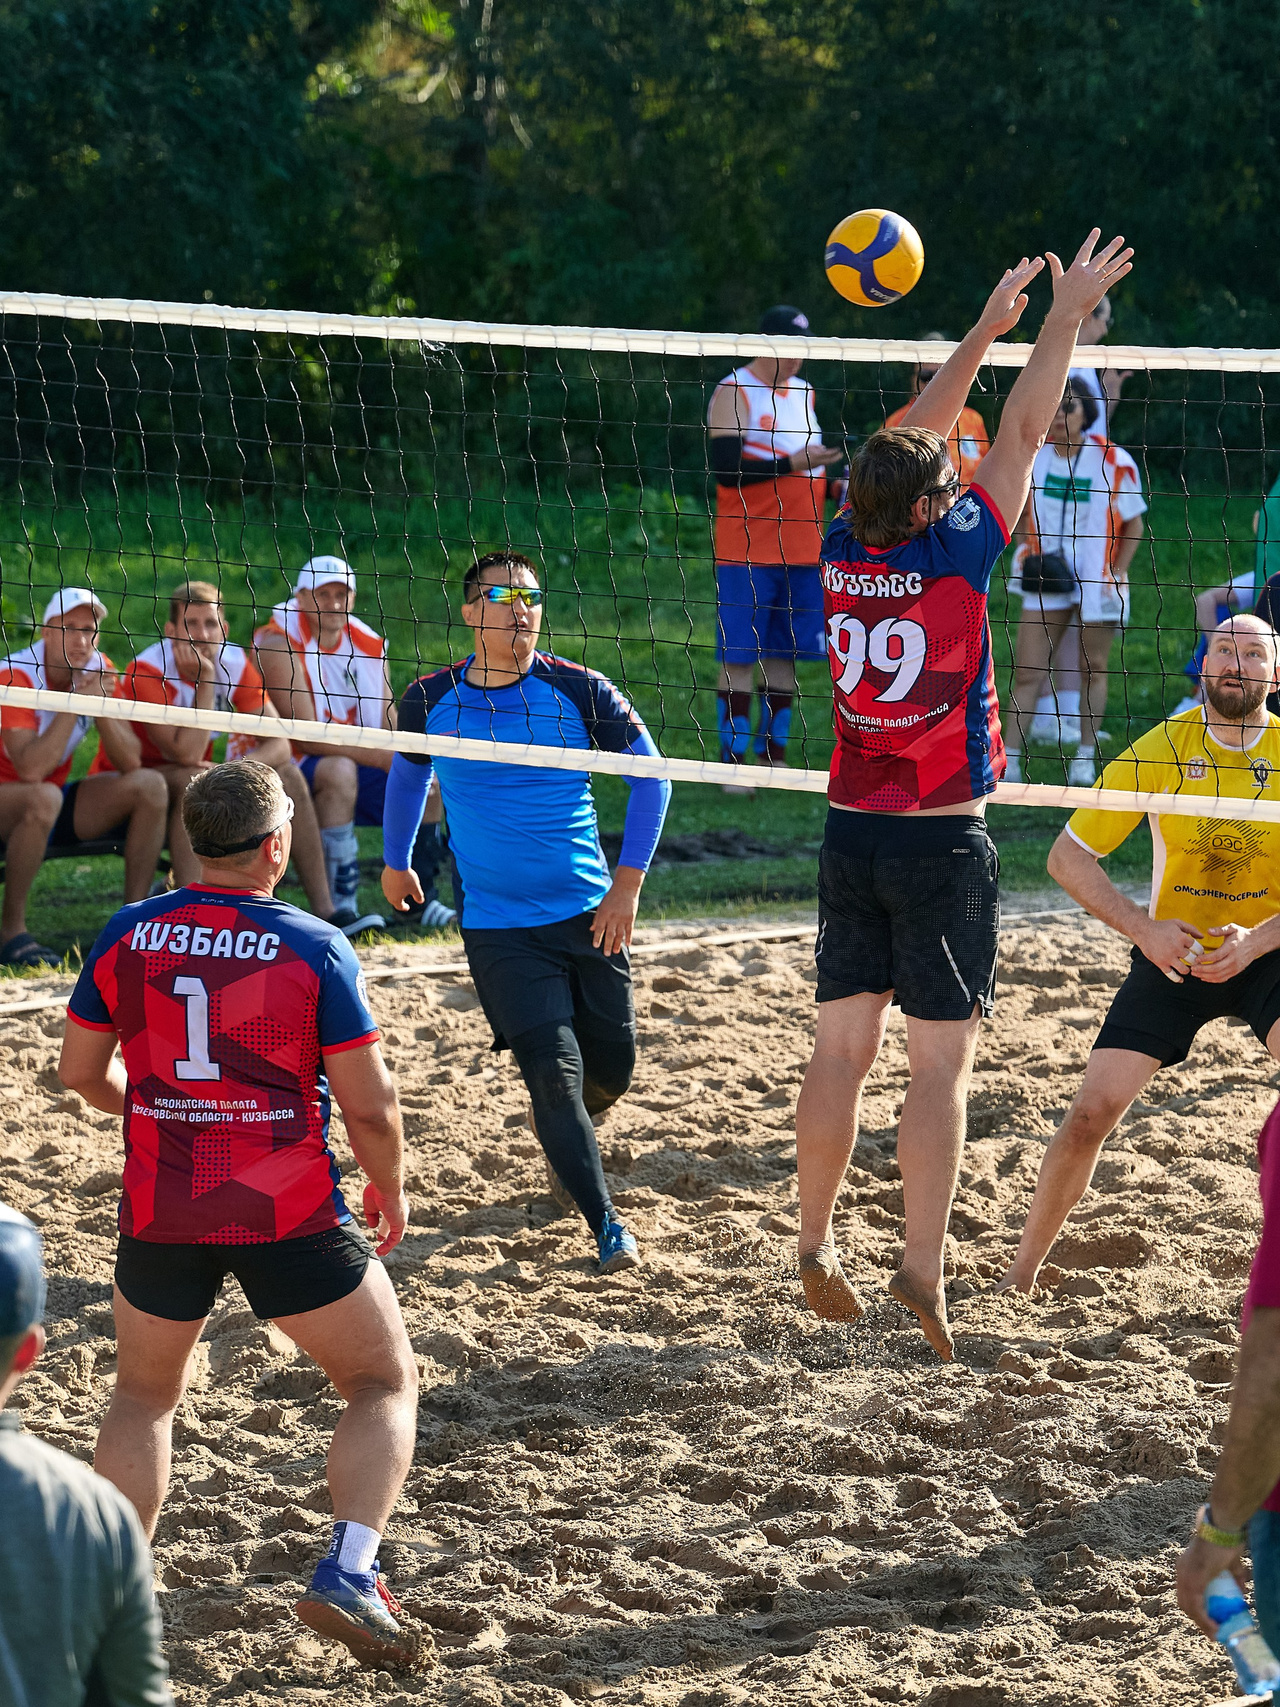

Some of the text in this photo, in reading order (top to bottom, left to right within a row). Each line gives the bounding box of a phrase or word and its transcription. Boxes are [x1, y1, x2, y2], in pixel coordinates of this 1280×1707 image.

[828, 613, 926, 702] 99
[1212, 837, 1243, 851] ОЭС
[1173, 885, 1269, 902] ОМСКЭНЕРГОСЕРВИС
[130, 921, 281, 961] КУЗБАСС
[172, 975, 222, 1081] 1
[219, 1099, 257, 1110] ПАЛАТА
[189, 1112, 234, 1123] ОБЛАСТИ
[242, 1108, 295, 1123] КУЗБАССА
